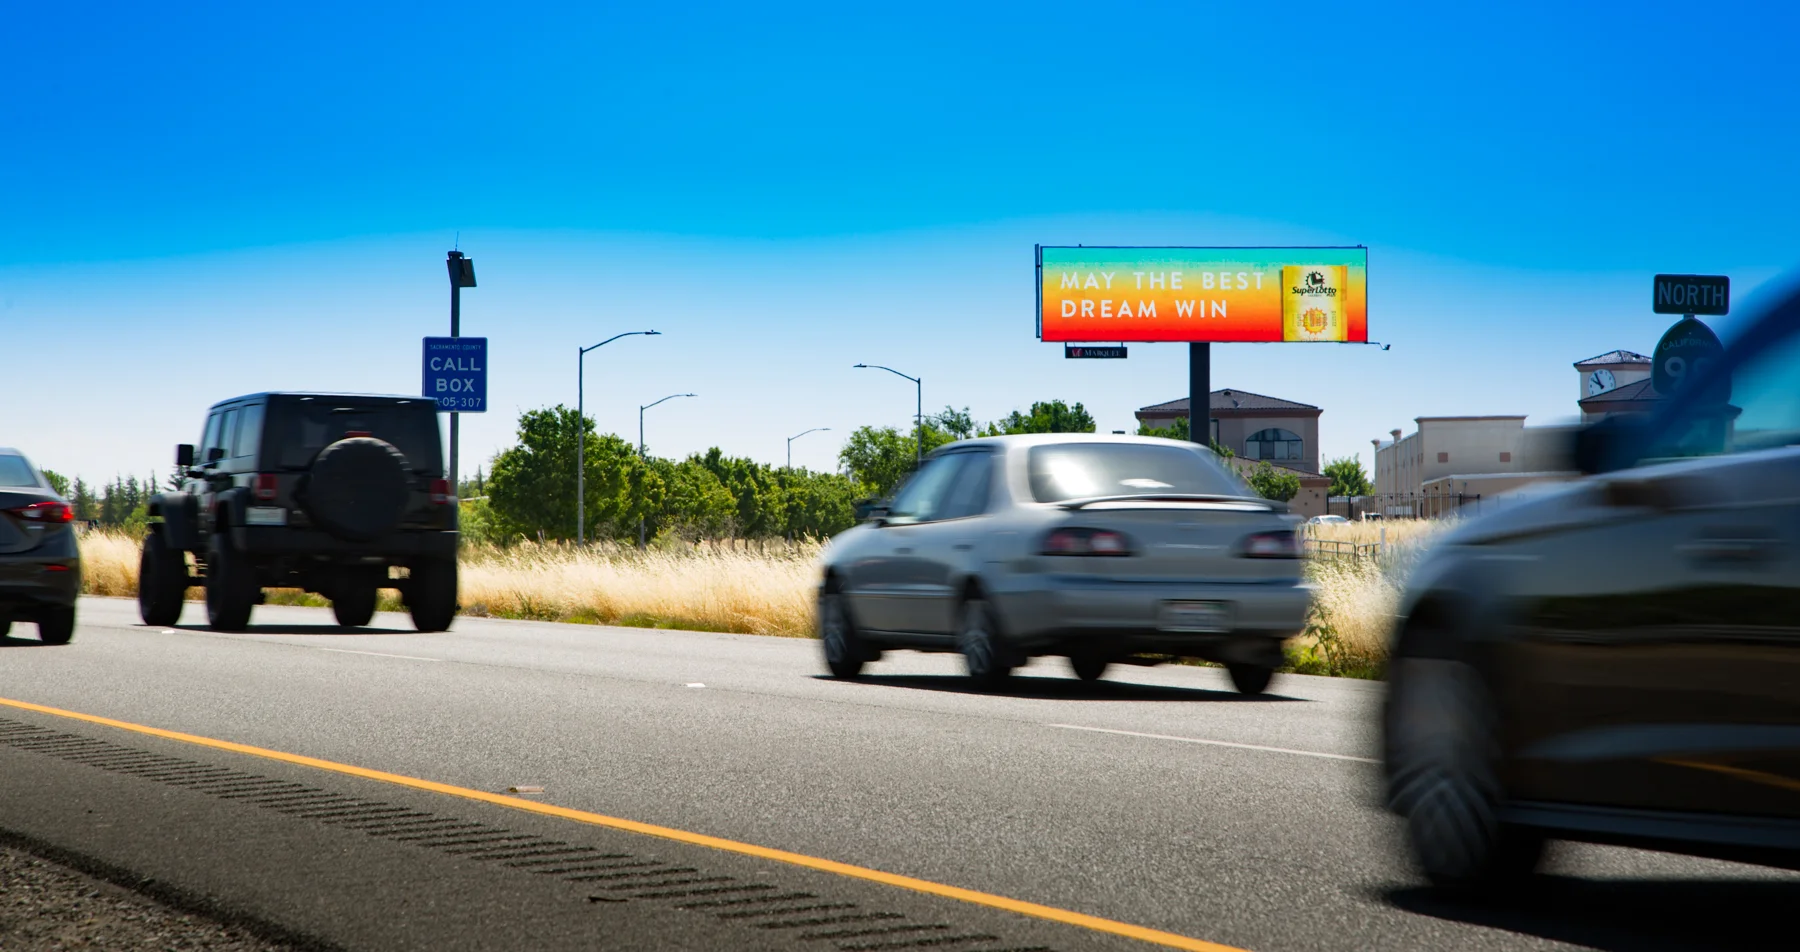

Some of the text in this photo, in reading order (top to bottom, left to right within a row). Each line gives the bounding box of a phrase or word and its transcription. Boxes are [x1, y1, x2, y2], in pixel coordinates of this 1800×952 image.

[1060, 271, 1265, 290] MAY THE BEST
[1658, 281, 1725, 307] NORTH
[1061, 299, 1227, 318] DREAM WIN
[1662, 338, 1717, 351] CALIFORNI
[430, 356, 482, 371] CALL
[436, 378, 475, 392] BOX
